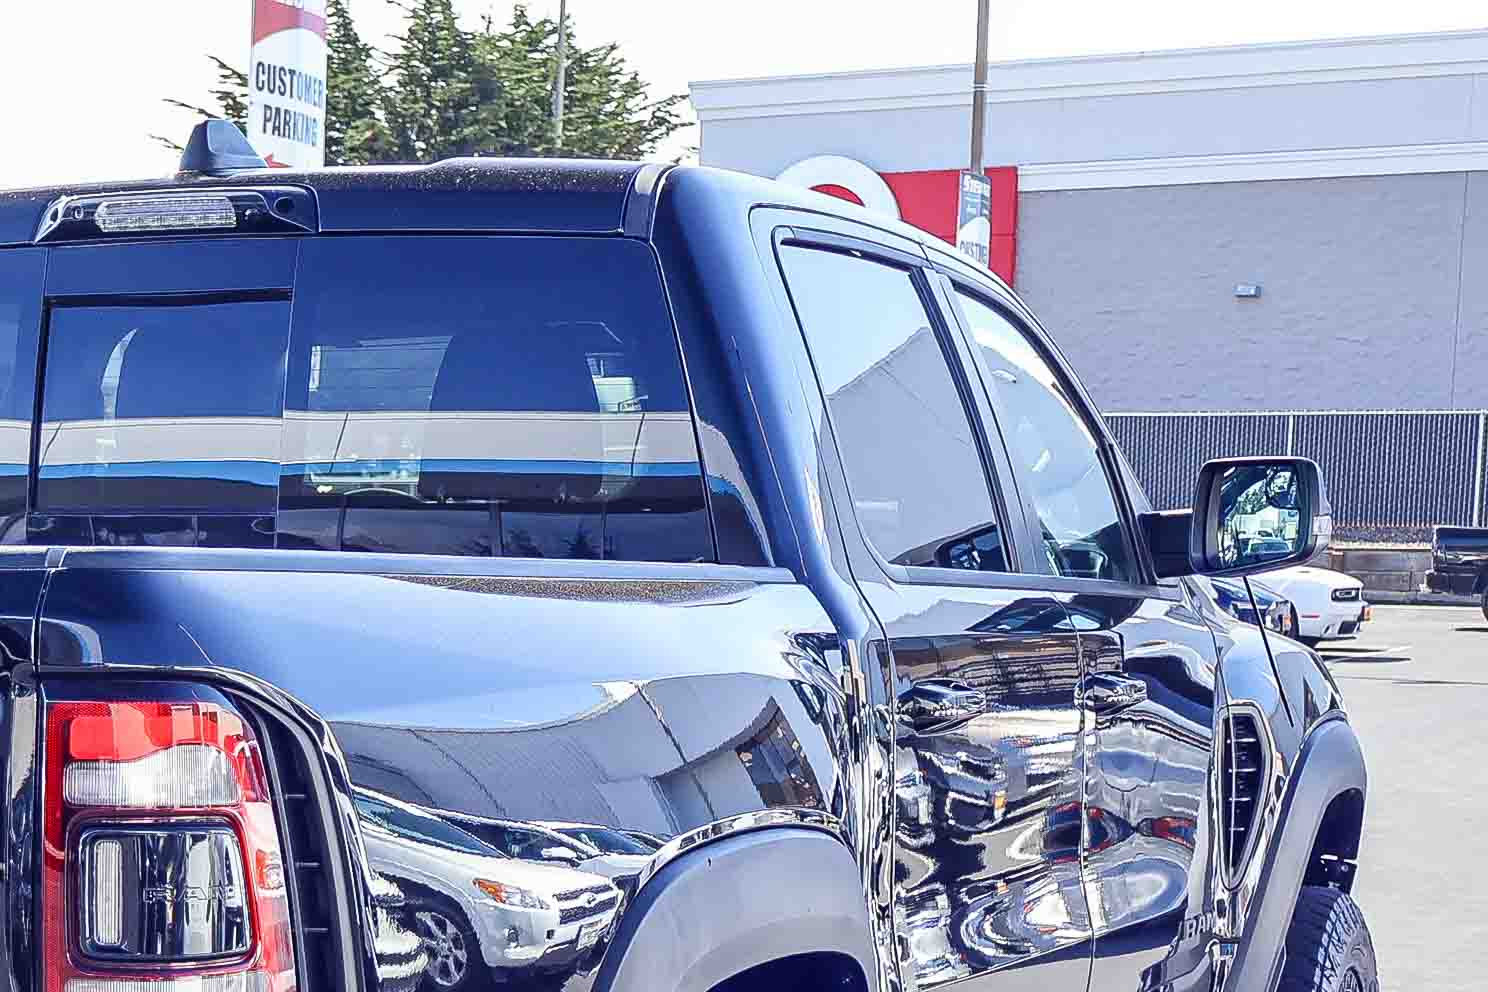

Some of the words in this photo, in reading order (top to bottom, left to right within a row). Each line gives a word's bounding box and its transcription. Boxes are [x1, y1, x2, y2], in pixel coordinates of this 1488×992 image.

[255, 61, 324, 108] CUSTOMER
[262, 104, 319, 147] PARKING
[142, 885, 236, 903] RAM
